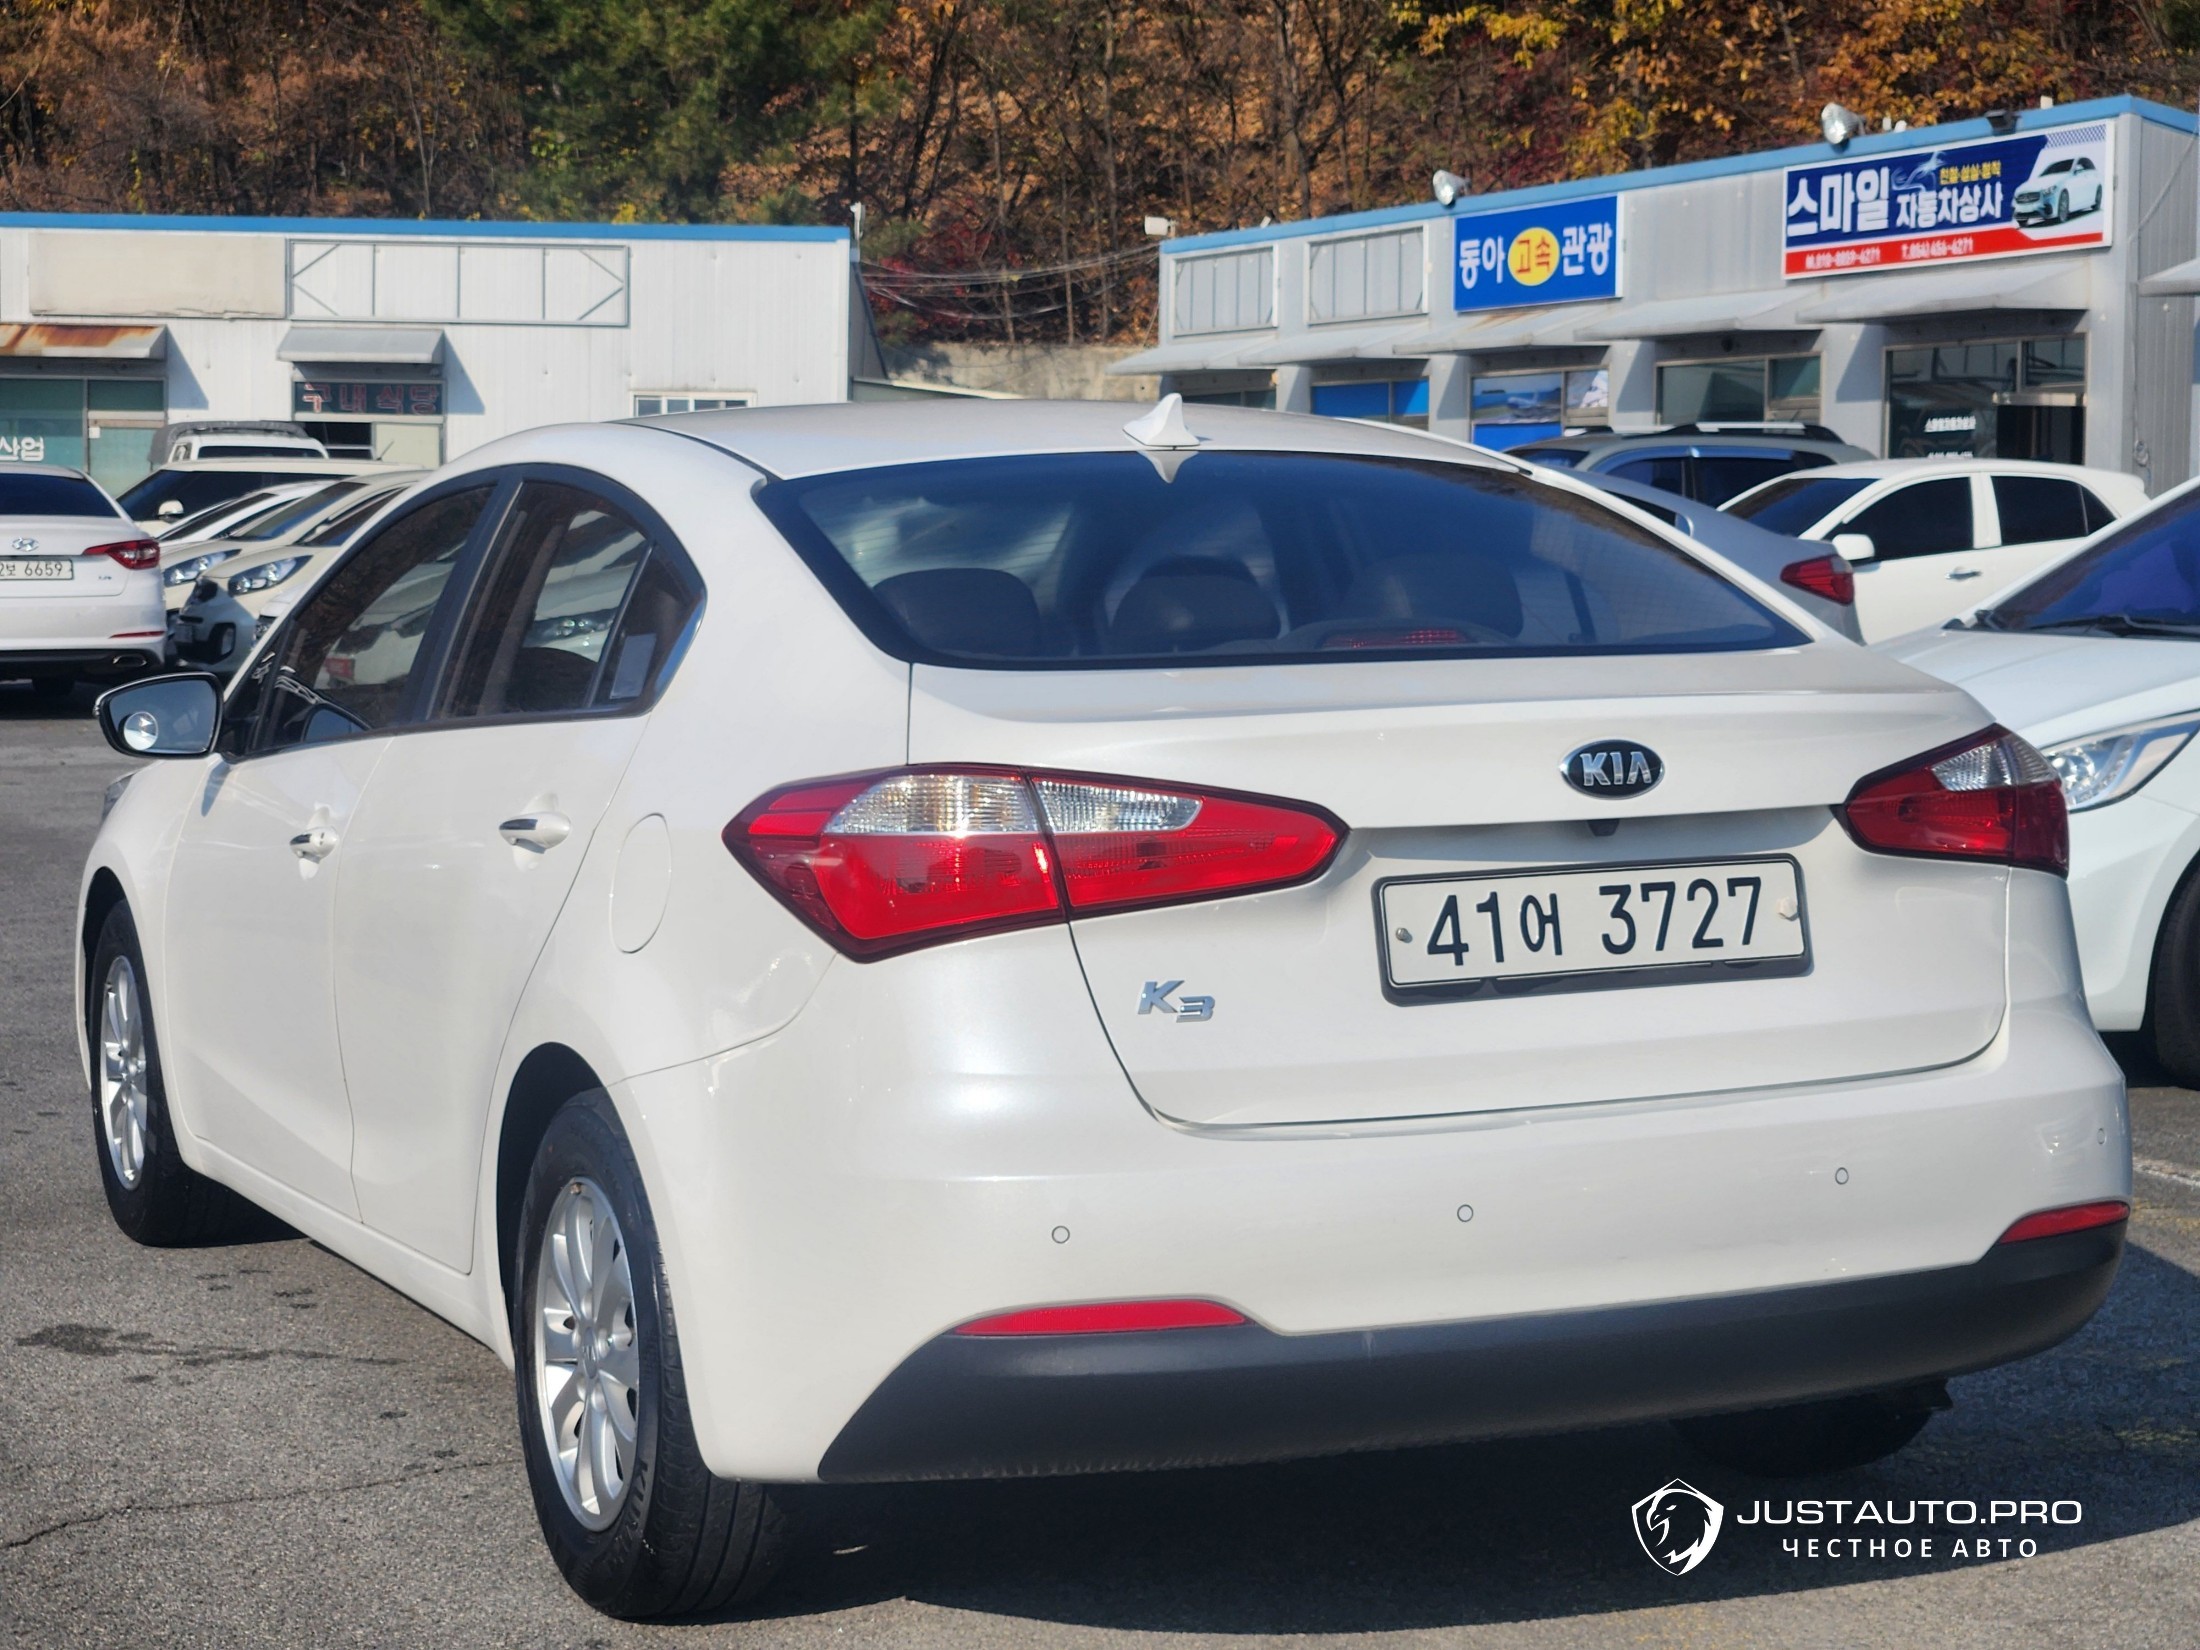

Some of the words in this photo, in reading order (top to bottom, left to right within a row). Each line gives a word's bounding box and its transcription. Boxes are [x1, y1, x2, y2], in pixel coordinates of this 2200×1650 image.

[1787, 167, 1890, 237] 스마일
[1896, 182, 2003, 229] 자동차상사
[1459, 235, 1505, 289] 동아
[1517, 235, 1551, 274] 고속
[1562, 221, 1613, 277] 관광
[303, 383, 438, 416] 구내식당
[24, 561, 63, 577] 6659
[1579, 751, 1653, 786] KIA
[1427, 891, 1563, 967] 41어
[1599, 876, 1762, 956] 3727
[1137, 979, 1216, 1023] K3
